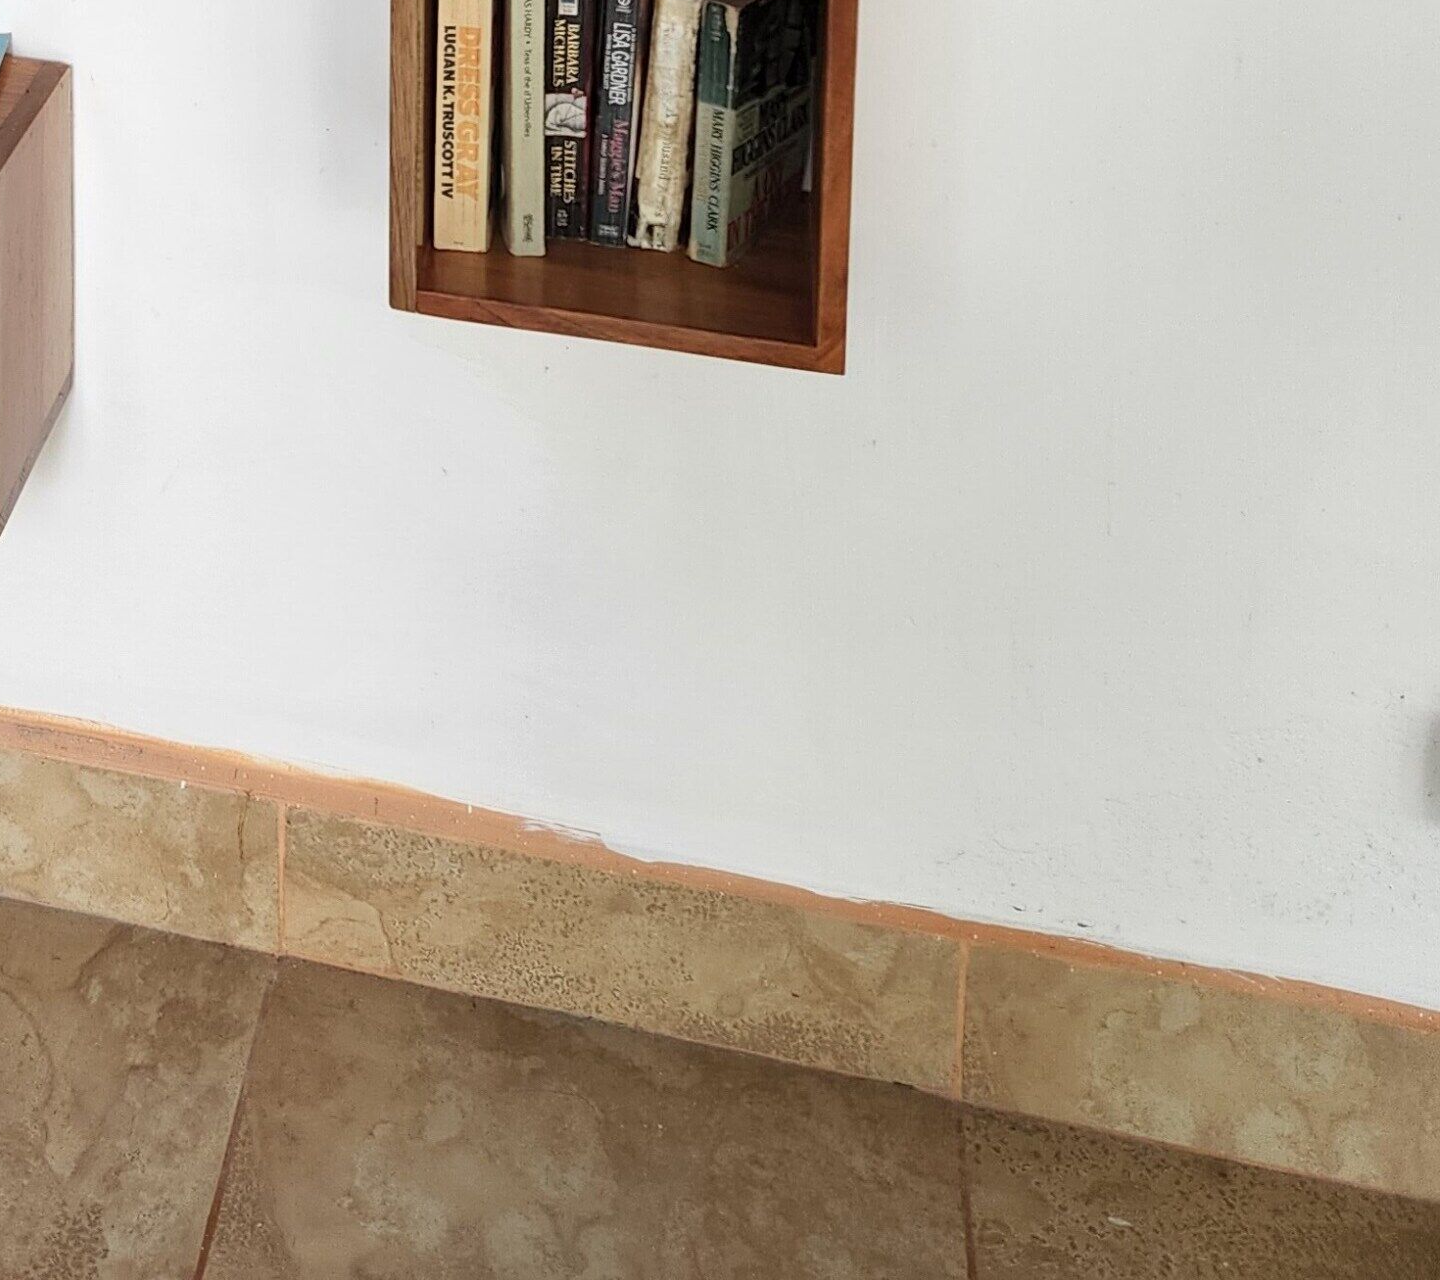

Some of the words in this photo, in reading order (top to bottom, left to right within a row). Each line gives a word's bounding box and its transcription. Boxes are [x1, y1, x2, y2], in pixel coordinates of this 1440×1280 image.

[523, 9, 532, 38] HARDY
[612, 22, 633, 49] LISA
[443, 25, 456, 82] LUCIAN
[457, 25, 482, 115] DRESS
[523, 49, 533, 66] Tess
[551, 18, 566, 87] MICHAELS
[566, 23, 580, 84] BARBARA
[443, 84, 456, 100] K.
[523, 76, 533, 89] the
[608, 50, 630, 105] GARDNER
[442, 102, 456, 180] TRUSCOTT
[710, 109, 725, 142] MARY
[456, 120, 480, 202] GRAY
[550, 146, 562, 162] IN
[607, 119, 630, 180] Maggie's
[708, 143, 723, 192] HIGGINS
[441, 182, 454, 200] IV
[550, 164, 563, 197] TIME
[563, 139, 577, 204] STITCHES
[607, 181, 625, 213] Man
[705, 193, 721, 233] CLARK
